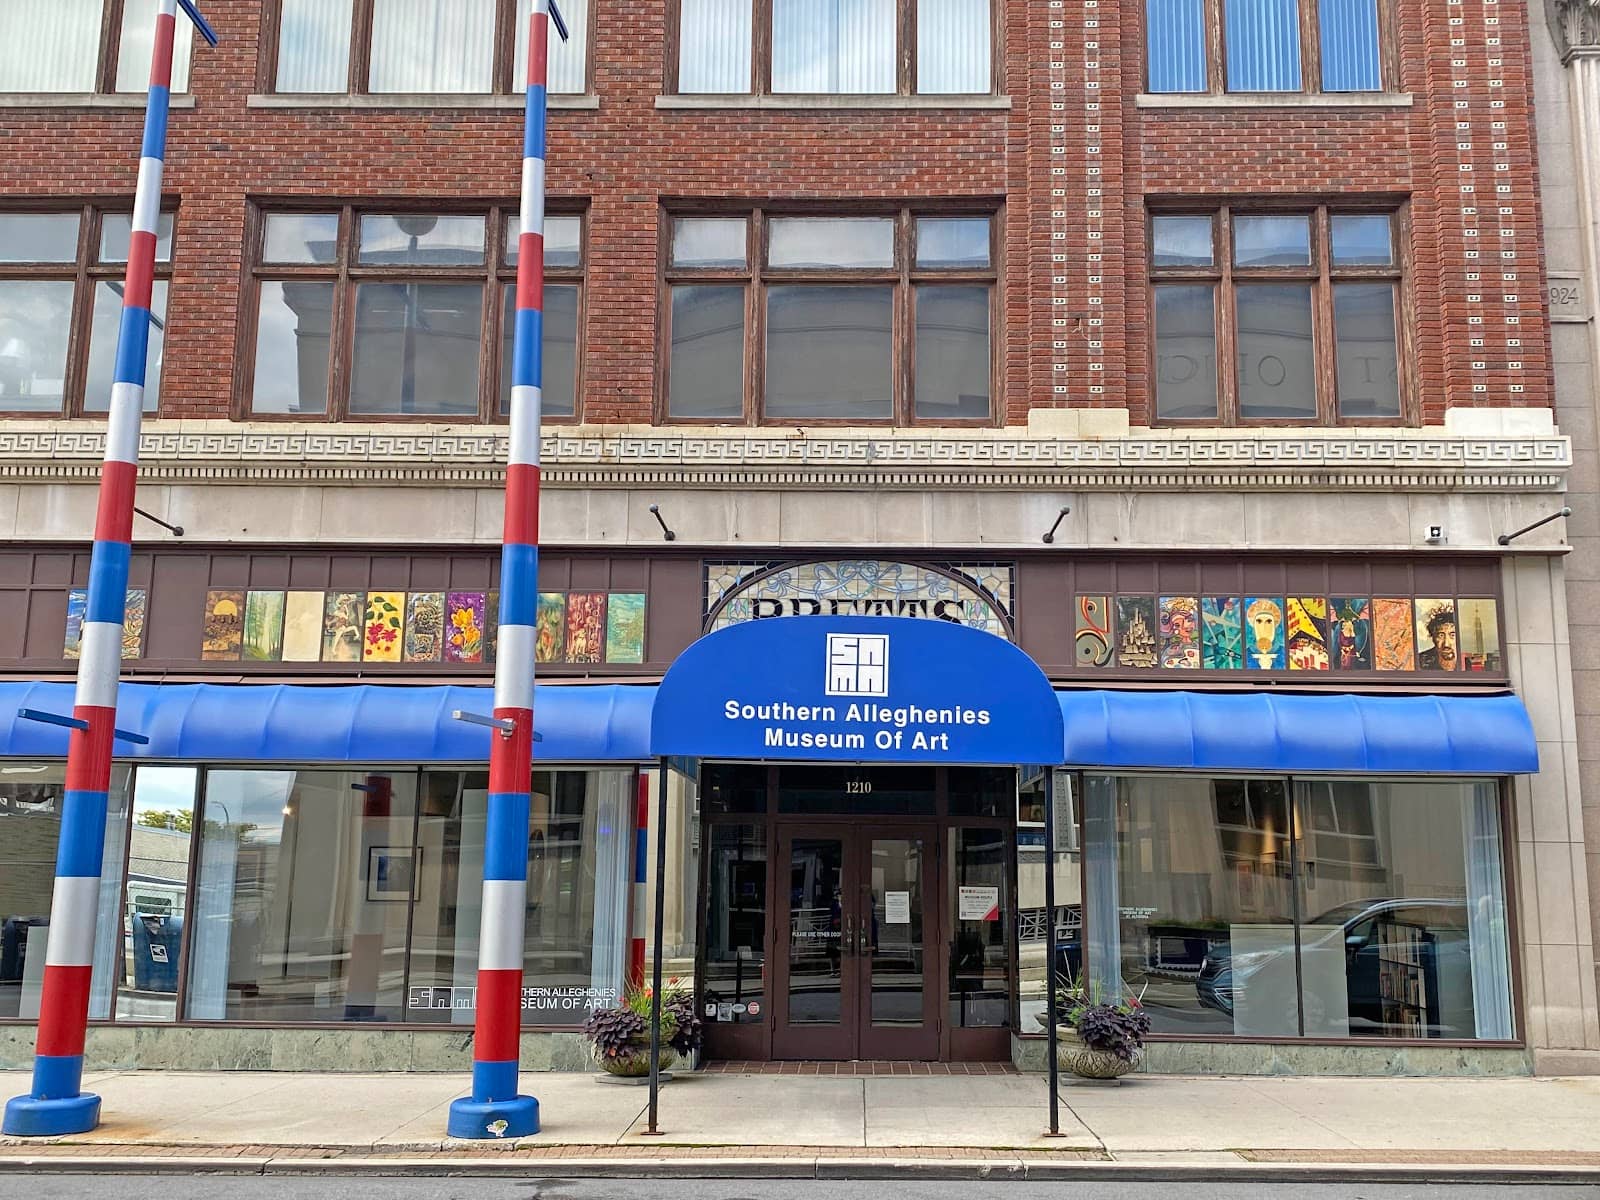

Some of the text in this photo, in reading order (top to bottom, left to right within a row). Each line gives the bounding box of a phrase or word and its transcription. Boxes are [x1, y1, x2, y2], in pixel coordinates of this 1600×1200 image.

[1550, 287, 1579, 304] 924
[724, 700, 991, 728] Southern Alleghenies
[764, 728, 949, 751] Museum Of Art
[846, 781, 872, 794] 1210
[520, 987, 616, 997] THERN ALLEGHENIES
[520, 997, 612, 1009] SEUM OF ART
